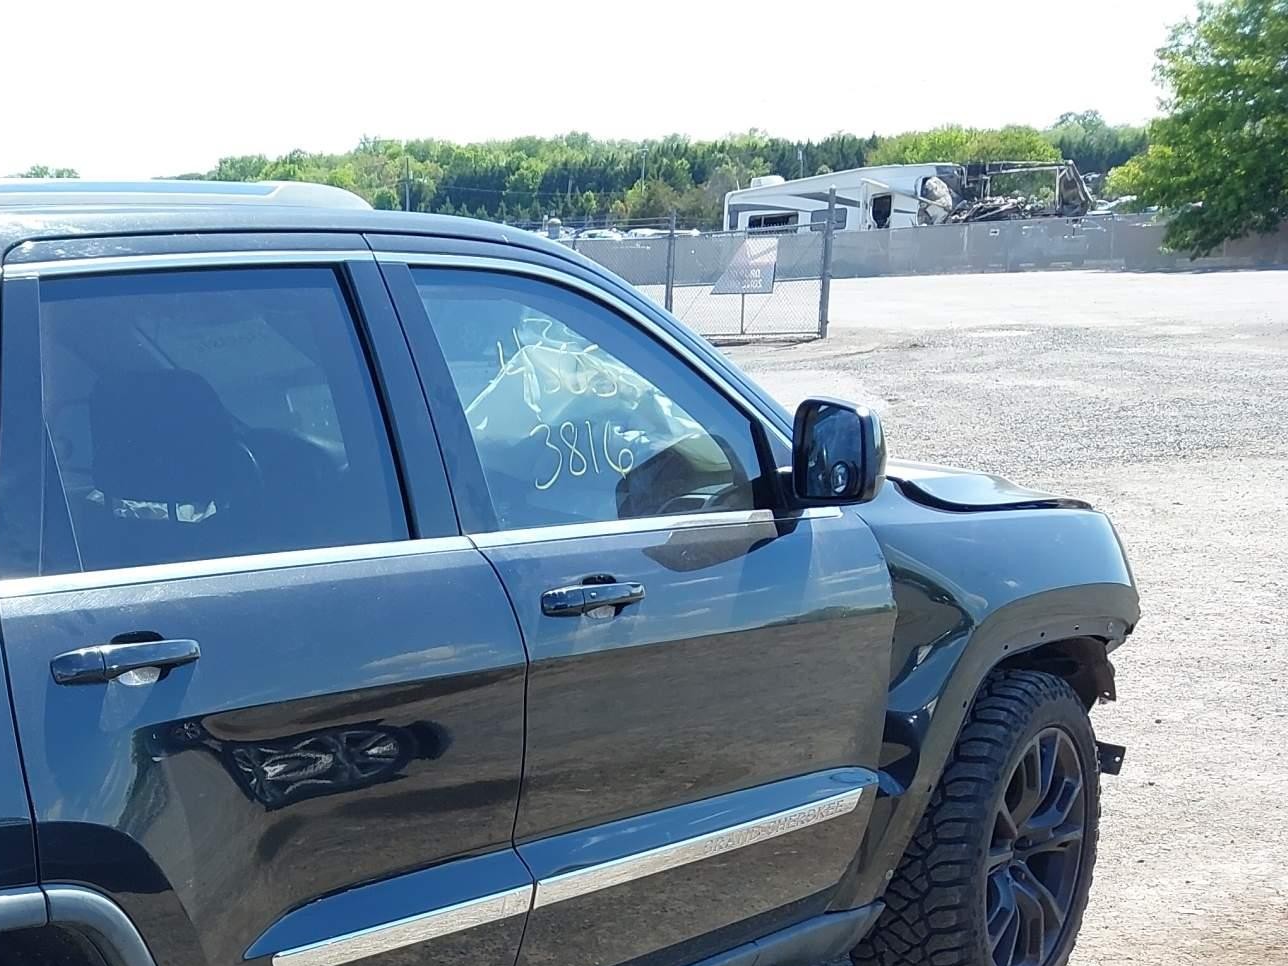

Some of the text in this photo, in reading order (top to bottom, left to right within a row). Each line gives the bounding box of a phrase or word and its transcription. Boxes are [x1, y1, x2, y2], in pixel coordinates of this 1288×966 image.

[528, 420, 634, 490] 3816
[704, 799, 845, 852] GRAND CHEROKEE
